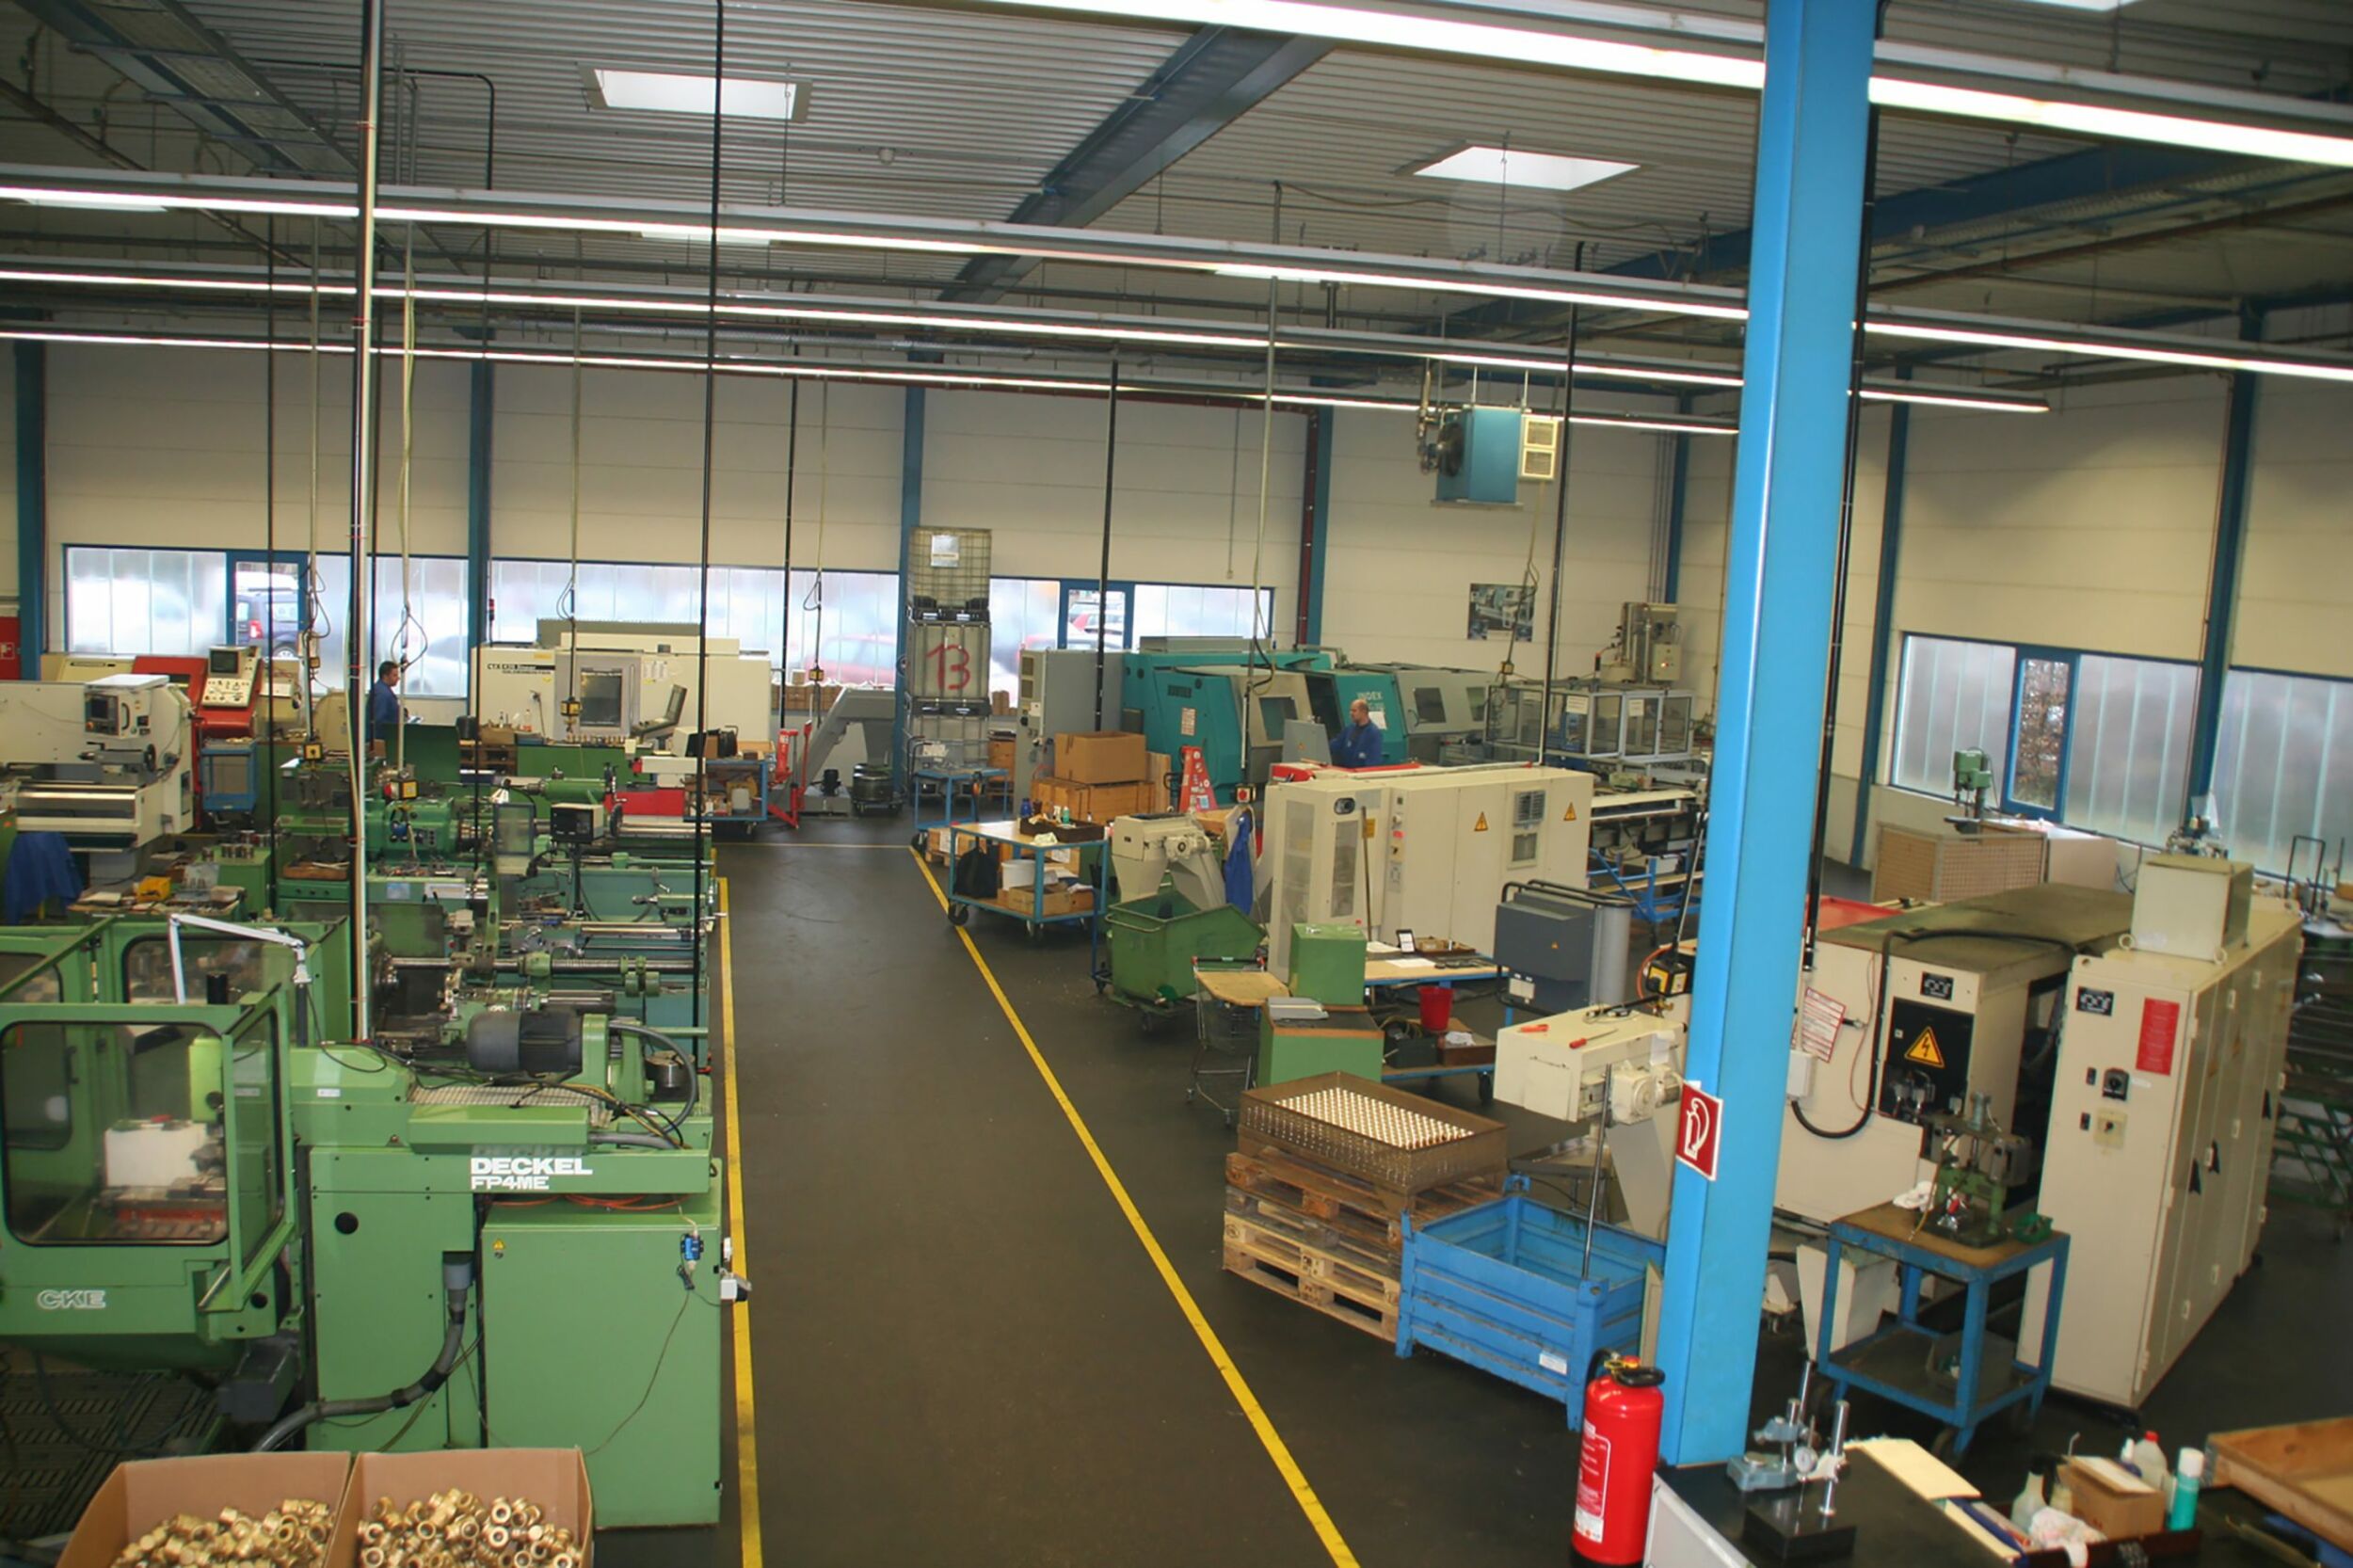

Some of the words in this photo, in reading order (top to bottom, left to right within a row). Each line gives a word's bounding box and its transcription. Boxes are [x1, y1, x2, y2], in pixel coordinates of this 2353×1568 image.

[925, 643, 970, 692] 13
[471, 1158, 593, 1176] DECKEL
[471, 1176, 550, 1191] FP4ME
[37, 1288, 106, 1310] CKE
